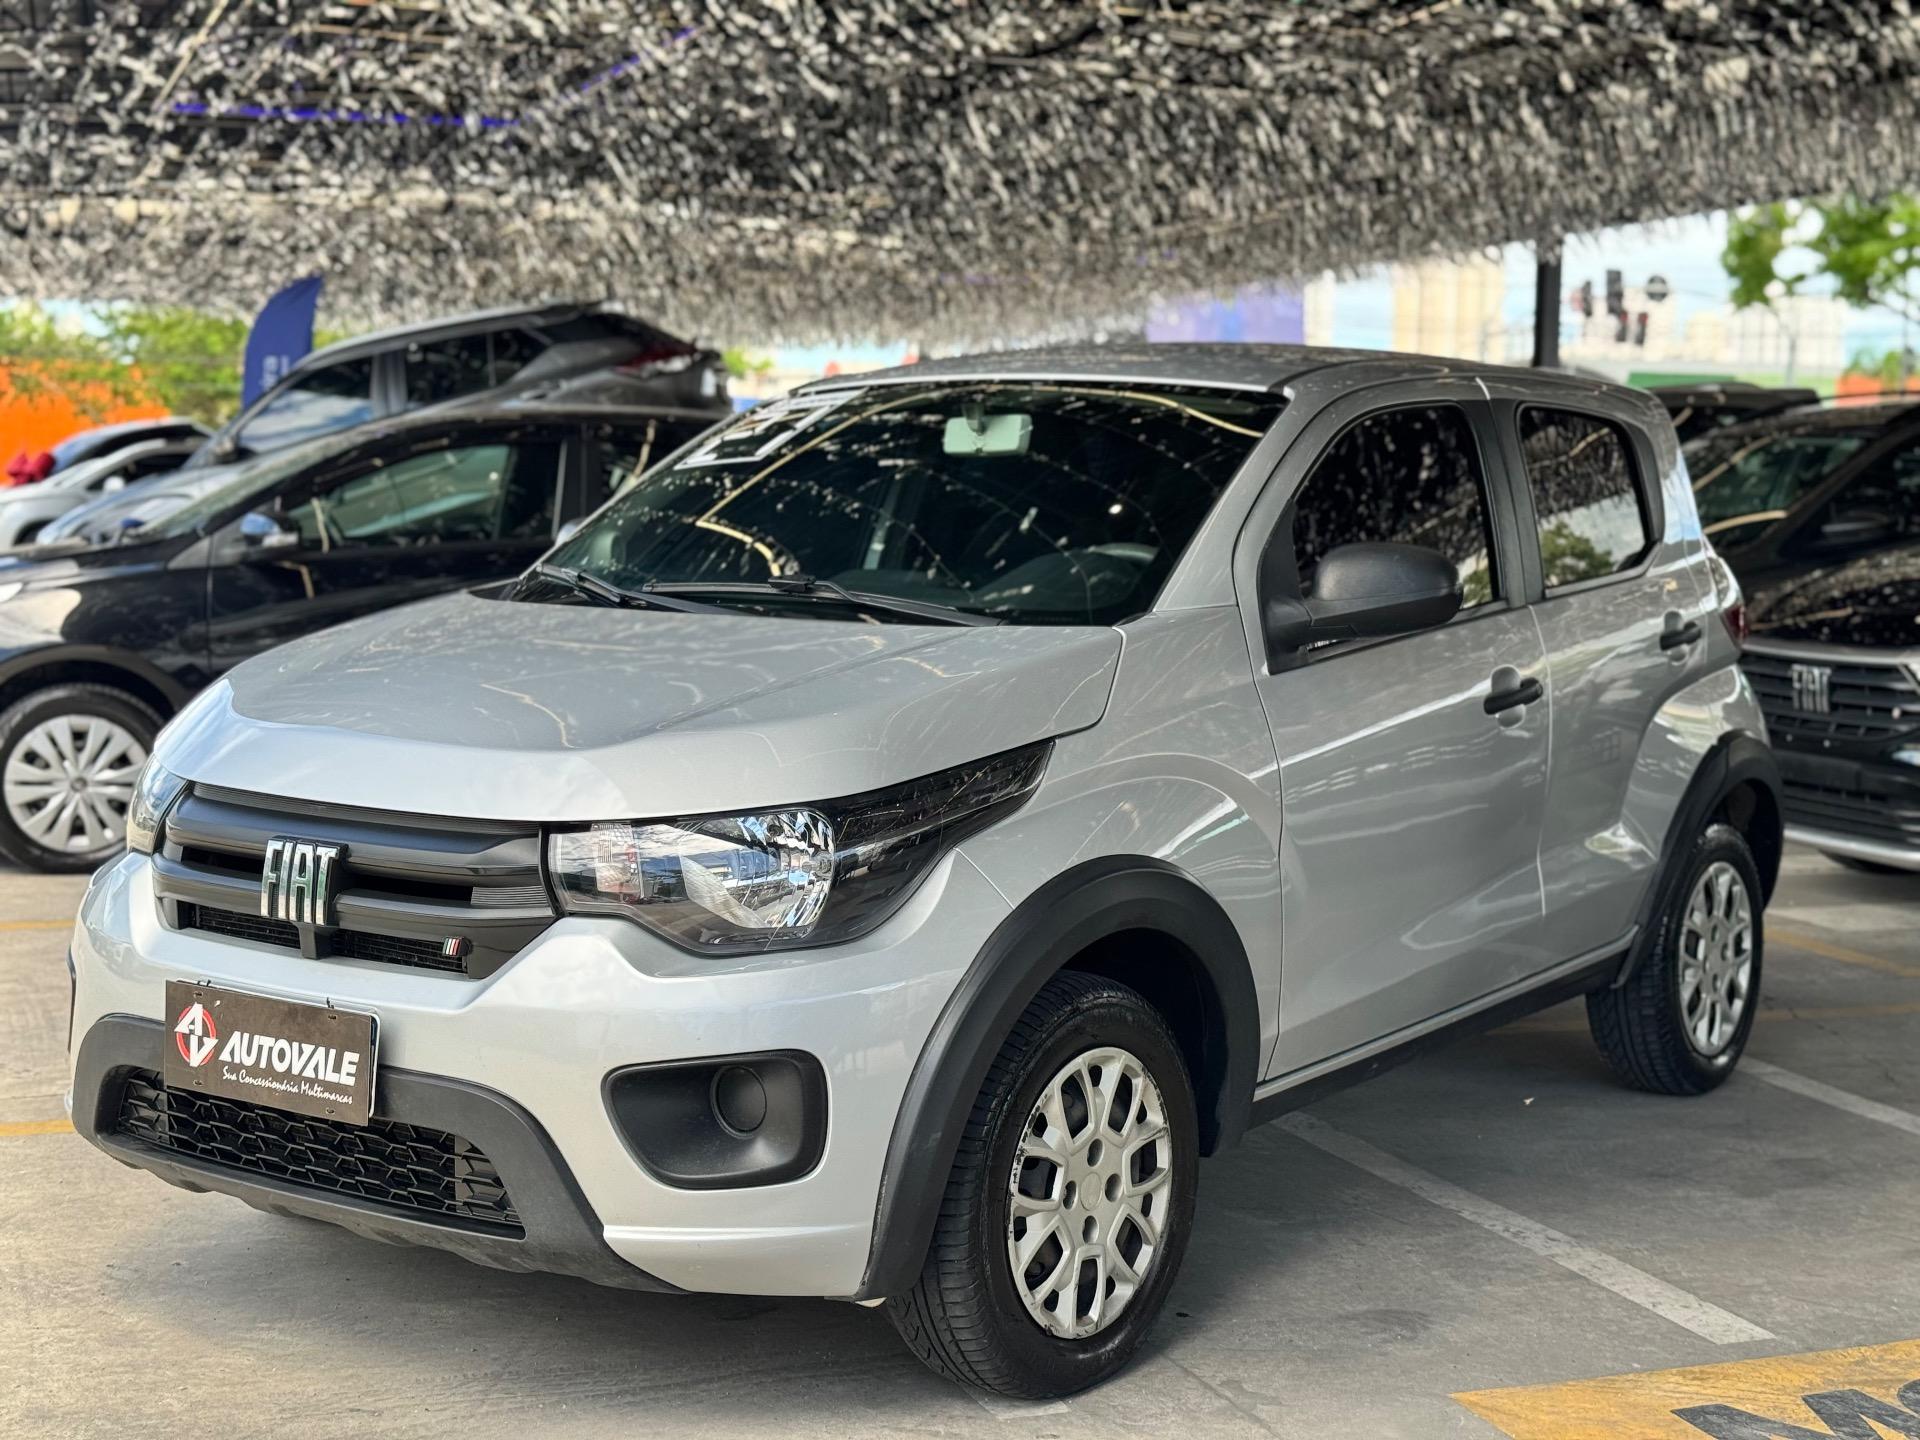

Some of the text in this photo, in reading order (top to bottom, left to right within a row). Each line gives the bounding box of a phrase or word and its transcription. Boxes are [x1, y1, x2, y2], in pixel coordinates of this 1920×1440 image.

[1792, 663, 1832, 713] FIAT
[261, 839, 340, 926] FIAT
[219, 1031, 360, 1086] AUTOVALE
[222, 1065, 238, 1081] Sua
[301, 1081, 353, 1104] Multimarcas
